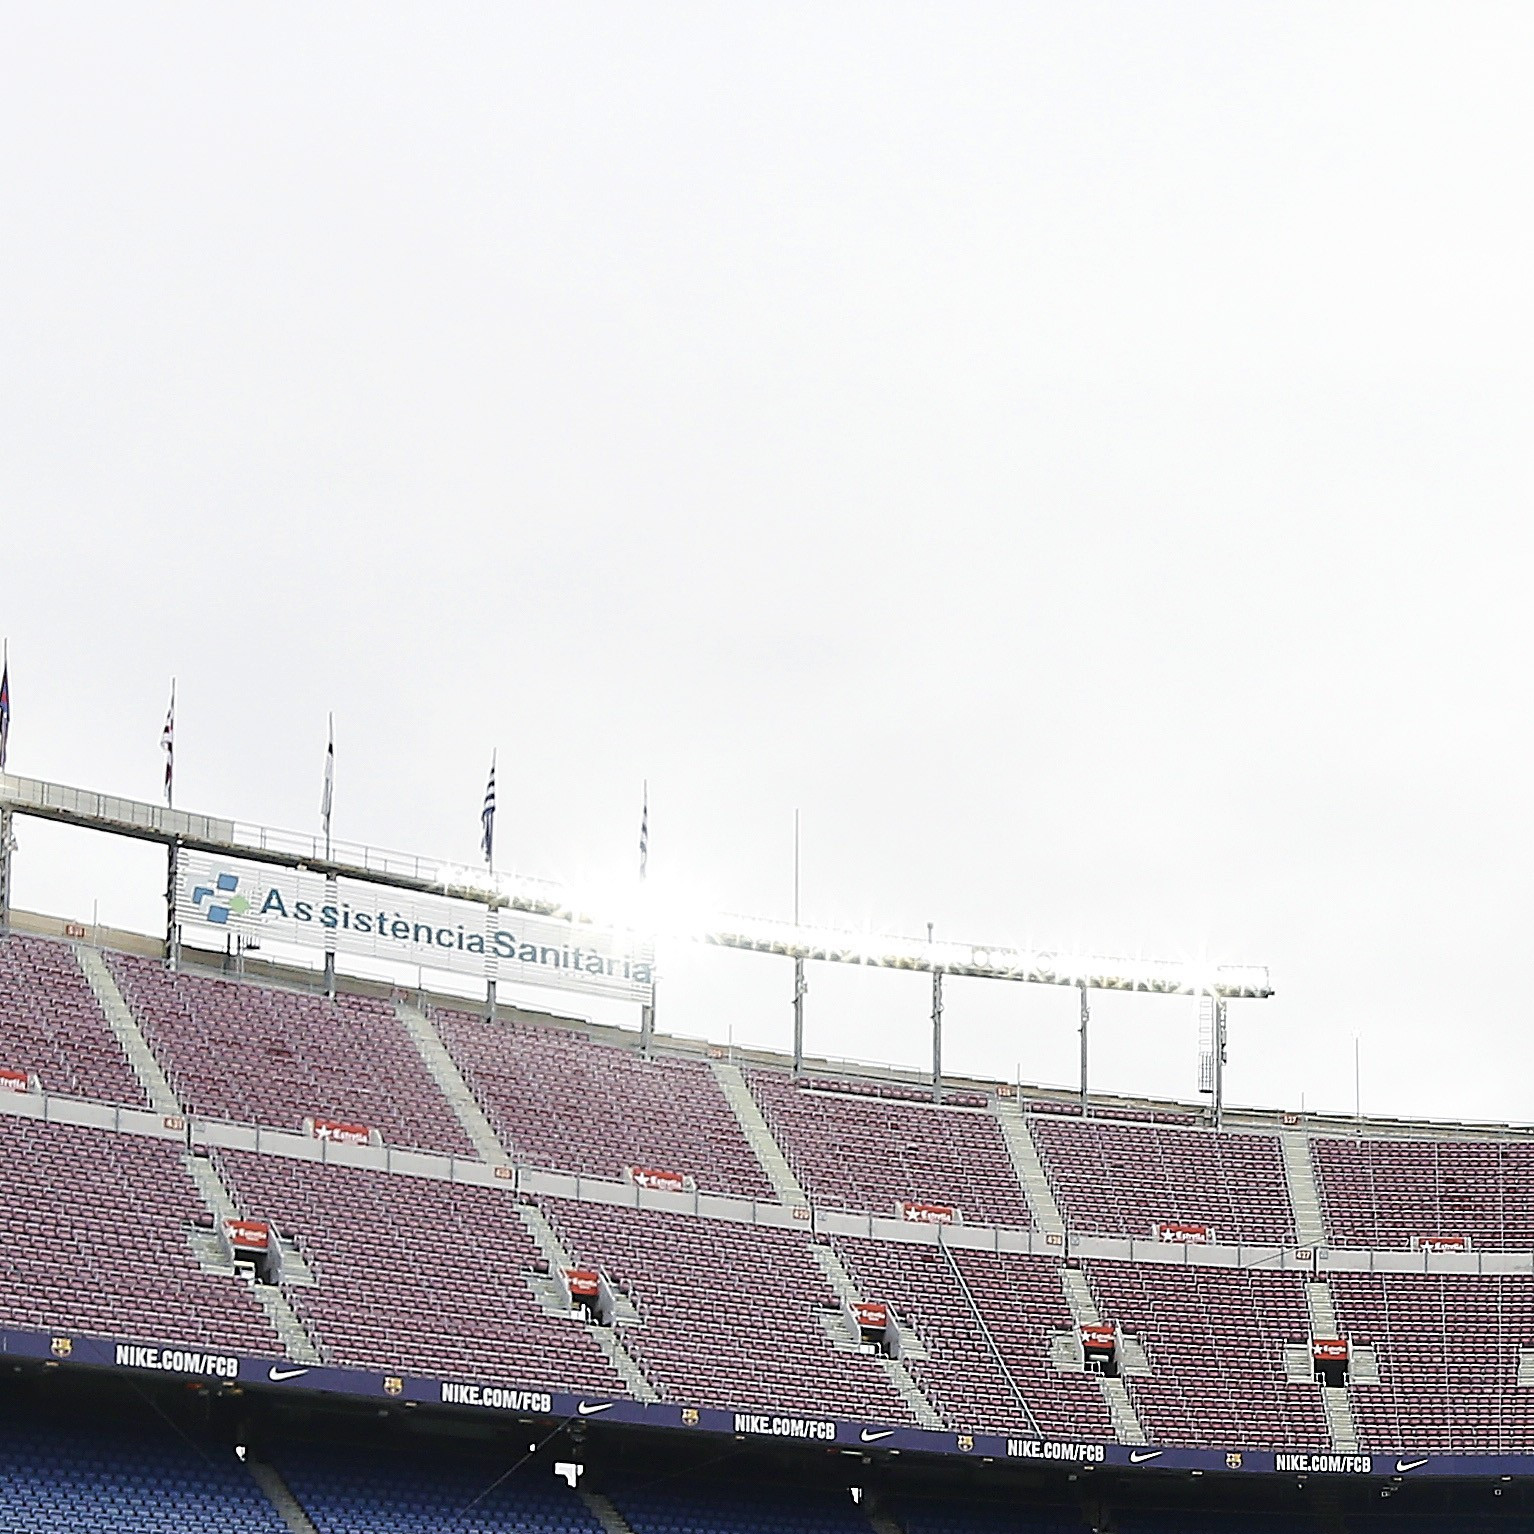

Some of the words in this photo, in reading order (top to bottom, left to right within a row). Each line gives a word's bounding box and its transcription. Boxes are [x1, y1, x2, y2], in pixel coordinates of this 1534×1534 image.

[115, 1344, 238, 1378] NIKE.COM/FCB
[441, 1383, 552, 1413] NIKE.COM/FCB
[734, 1414, 836, 1441] NIKE.COM/FCB
[1006, 1439, 1105, 1463] NIKE.COM/FCB
[1275, 1455, 1371, 1473] NIKE.COM/FCB
